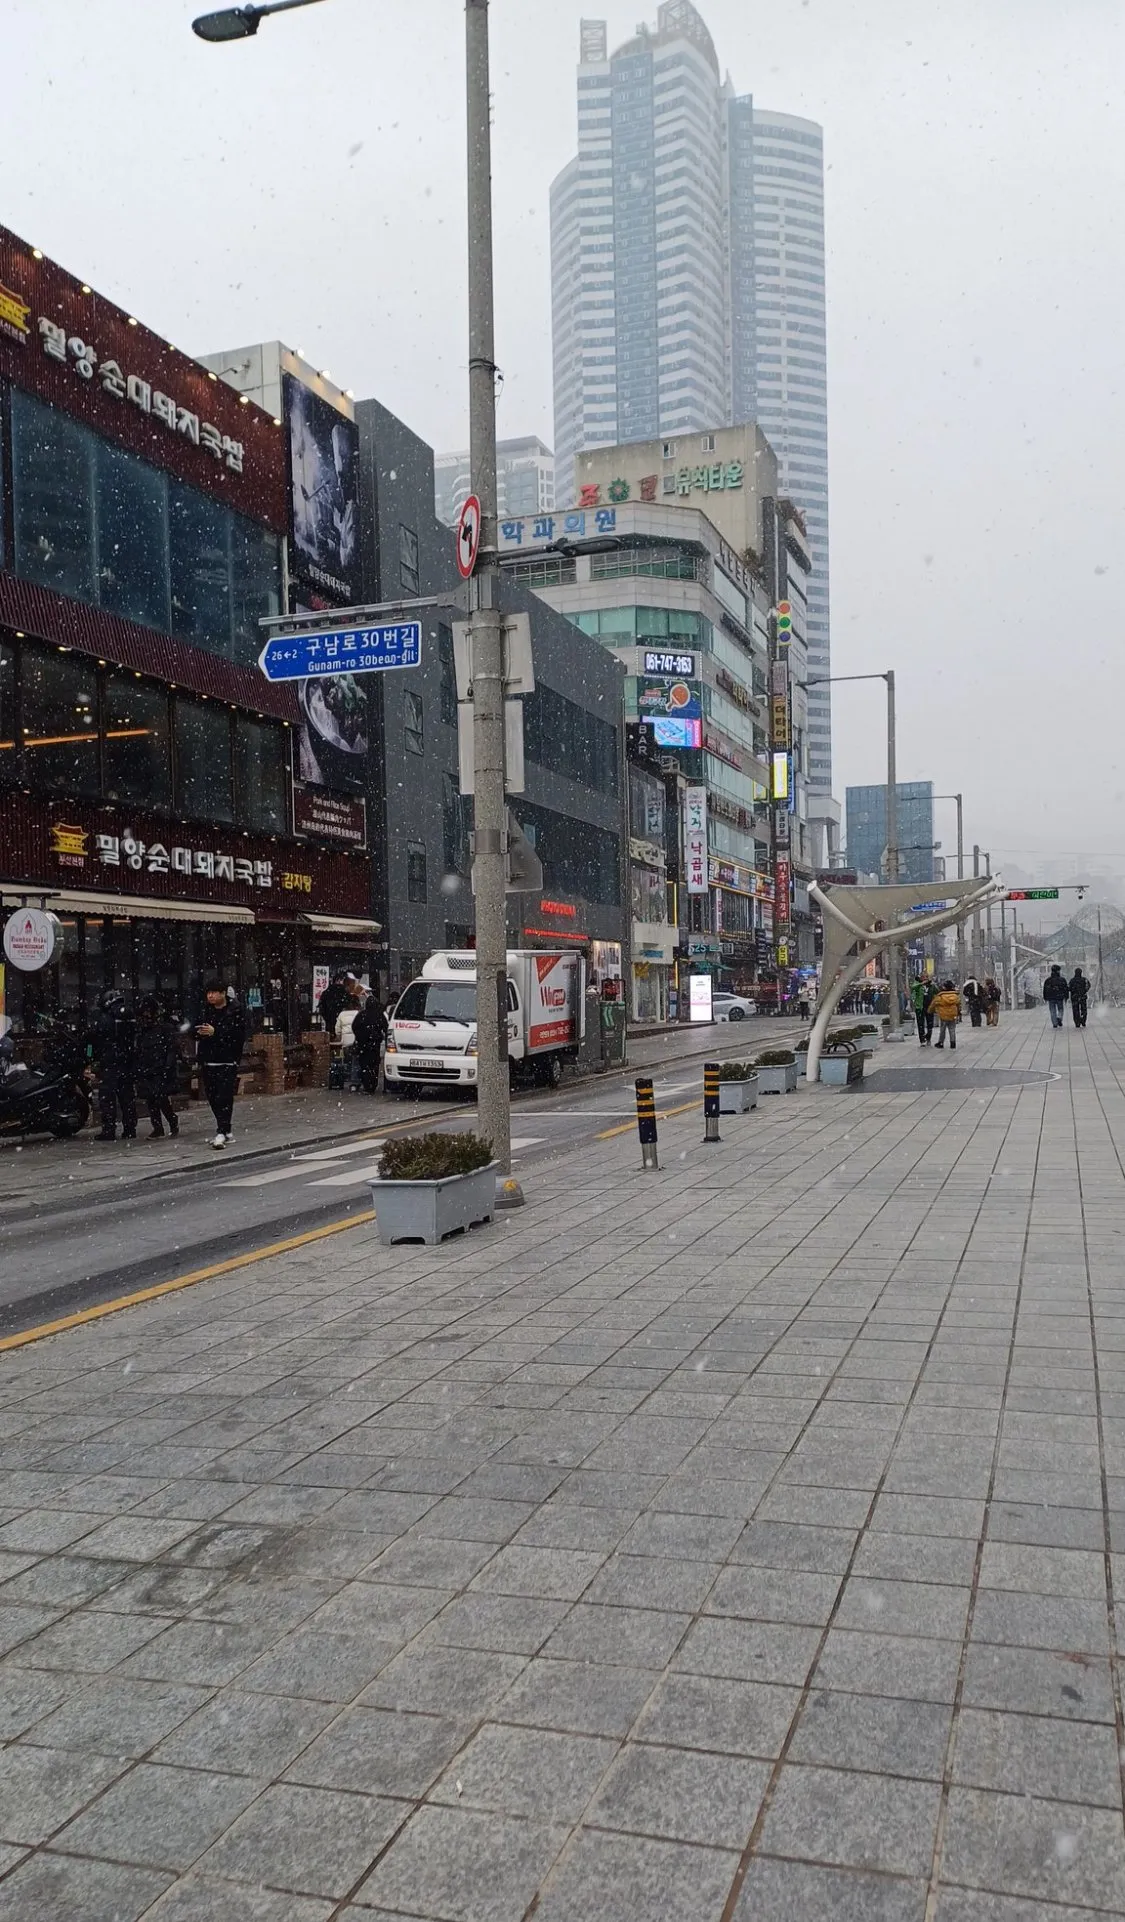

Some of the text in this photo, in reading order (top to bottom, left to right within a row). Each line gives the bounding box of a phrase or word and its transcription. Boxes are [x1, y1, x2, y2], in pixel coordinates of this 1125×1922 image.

[38, 316, 244, 473] 밀양순대돼지국밥
[271, 651, 283, 661] 26
[308, 650, 415, 672] Gunam-ro 30beon-gil
[638, 724, 648, 756] BAR
[96, 834, 272, 888] 밀양순대돼지국밥
[282, 872, 312, 893] 감자탕
